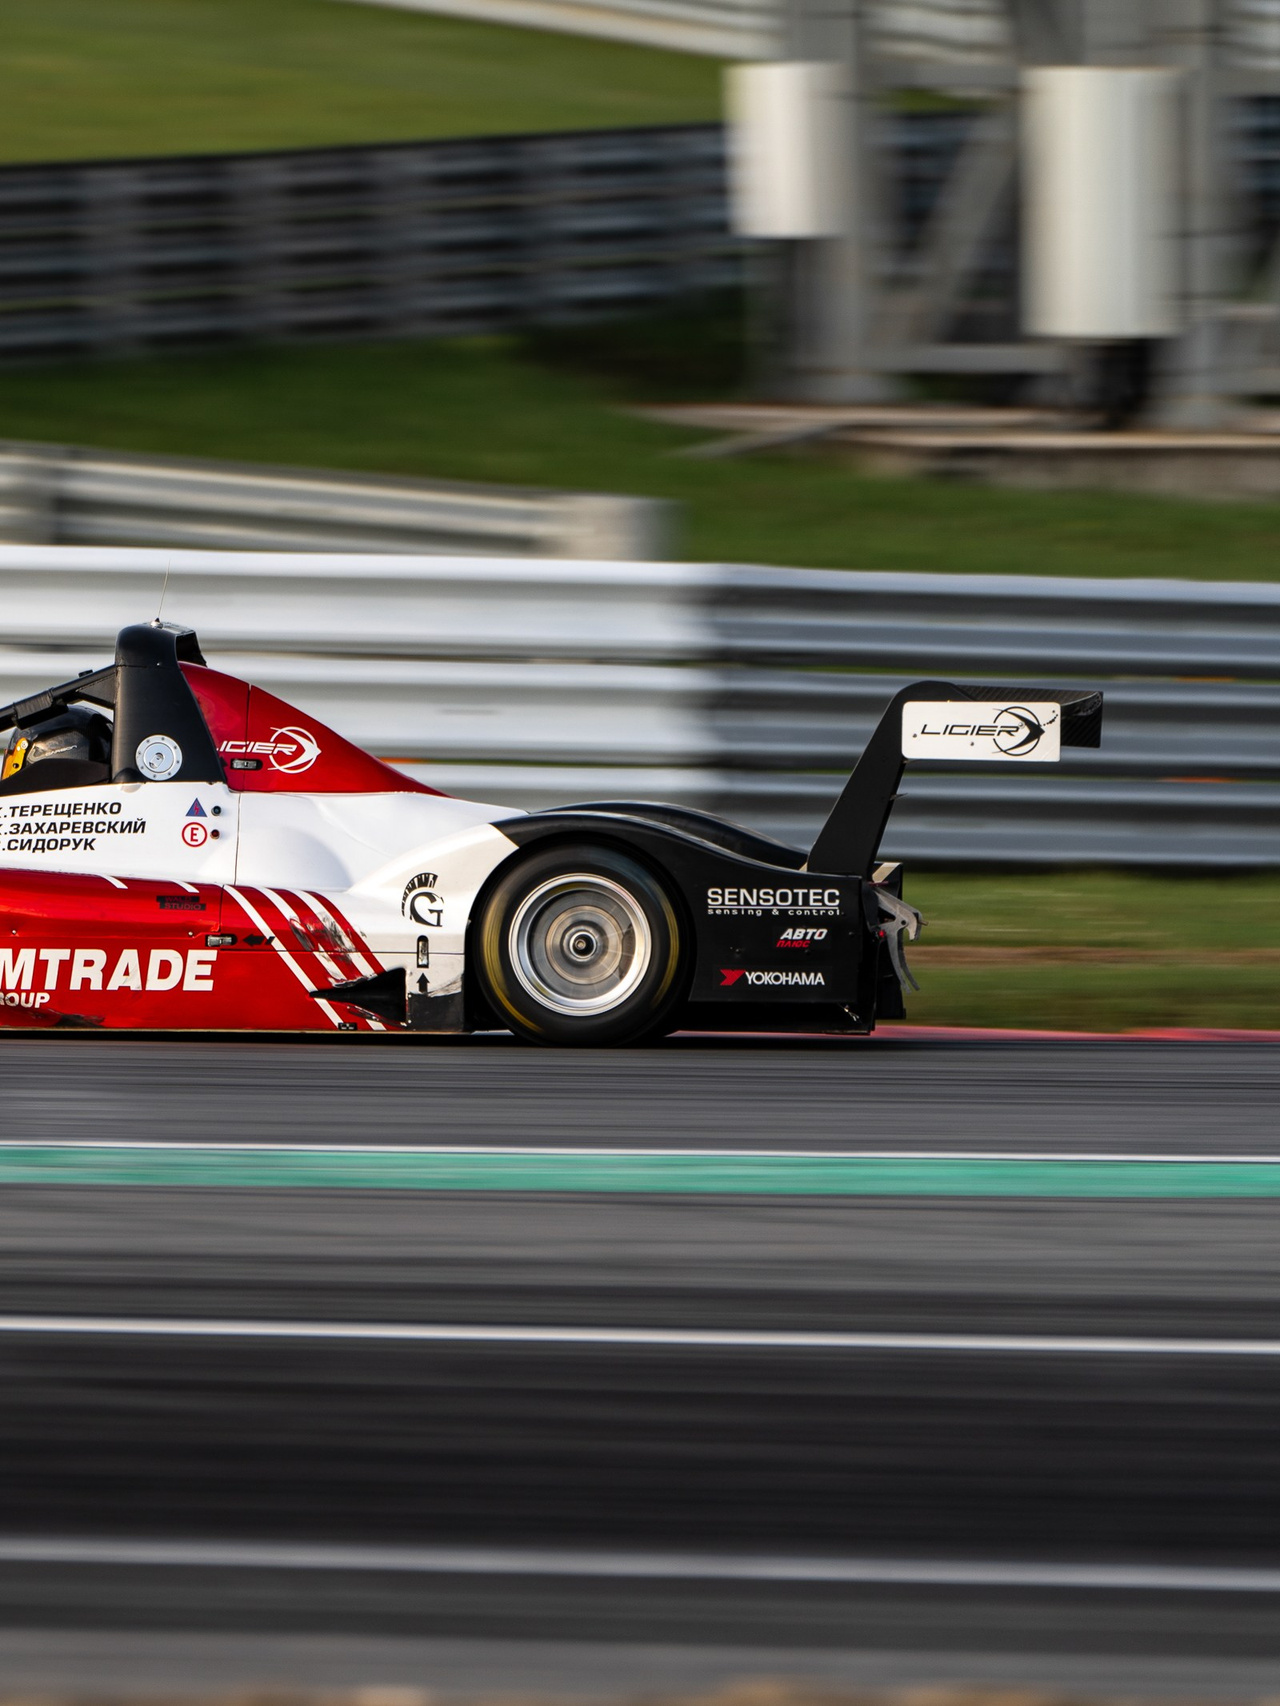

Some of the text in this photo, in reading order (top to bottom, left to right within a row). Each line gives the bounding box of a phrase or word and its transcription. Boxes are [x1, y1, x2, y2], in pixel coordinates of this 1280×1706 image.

[921, 723, 1020, 737] LIGIER
[216, 740, 297, 756] IGIER
[707, 888, 840, 906] SENSOTEC
[165, 902, 202, 910] STUDIO
[707, 908, 762, 917] sensing
[788, 908, 840, 916] control
[780, 928, 828, 940] АВТО
[776, 940, 811, 948] ПЛЮС
[745, 972, 825, 985] YOKOHAMA
